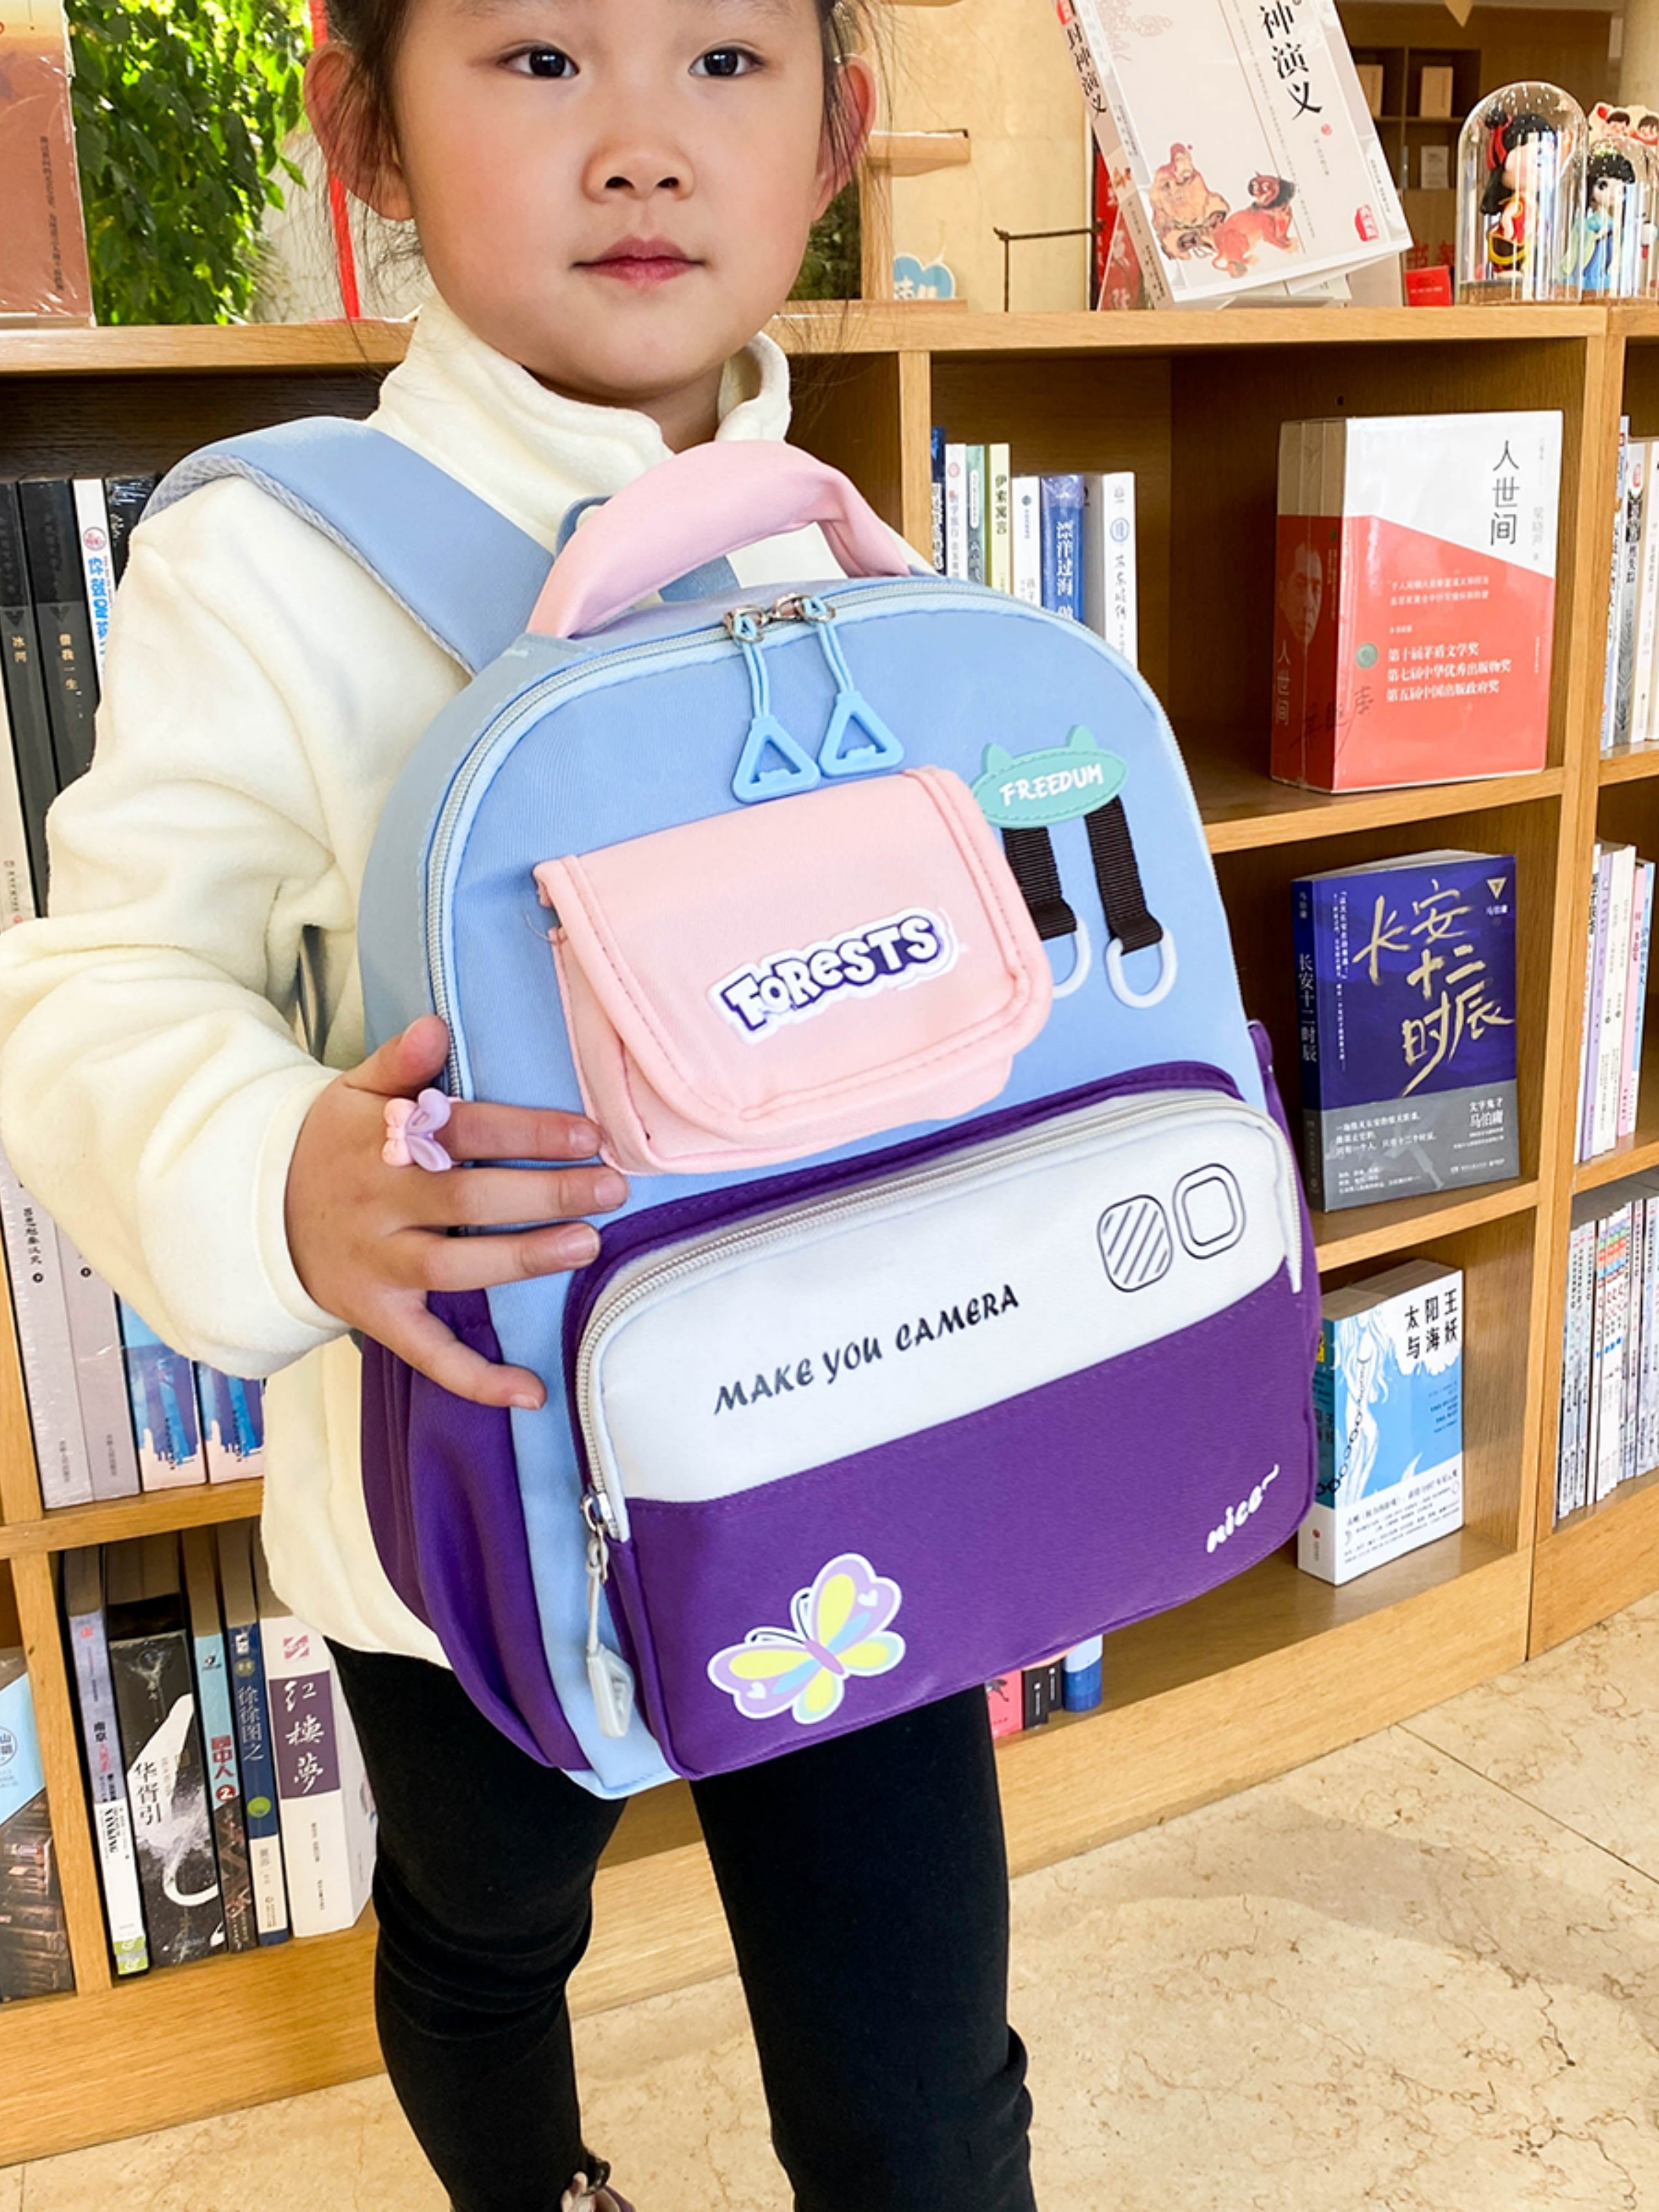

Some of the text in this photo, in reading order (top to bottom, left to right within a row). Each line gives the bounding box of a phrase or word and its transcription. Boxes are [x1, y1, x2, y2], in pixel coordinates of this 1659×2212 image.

[1490, 440, 1520, 545] 人世间
[999, 763, 1104, 807] FREEDUM
[1352, 879, 1473, 985] 长安
[1406, 943, 1486, 1001] 十二
[1299, 953, 1317, 1062] 长安十二时辰
[1397, 980, 1516, 1098] 时辰
[714, 1284, 1019, 1415] MAKE YOU CAMERA
[1405, 1288, 1458, 1332] 太阳王
[237, 1686, 264, 1762] 徐徐图之
